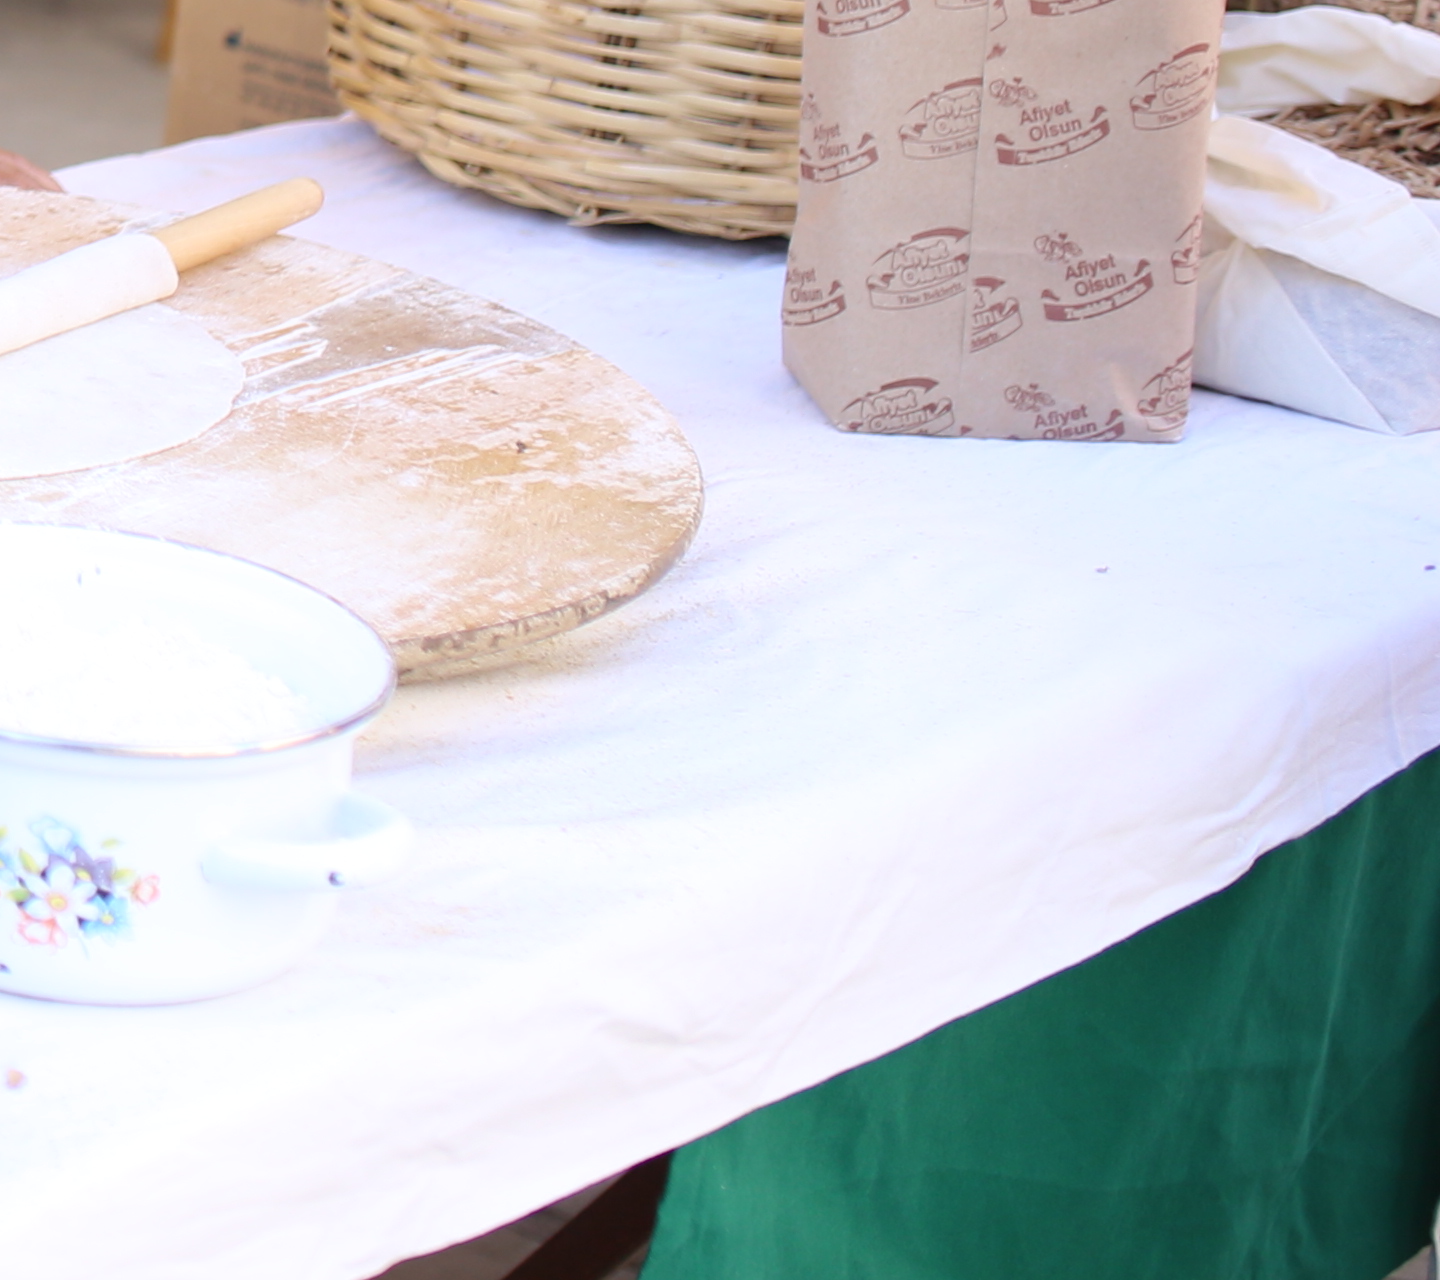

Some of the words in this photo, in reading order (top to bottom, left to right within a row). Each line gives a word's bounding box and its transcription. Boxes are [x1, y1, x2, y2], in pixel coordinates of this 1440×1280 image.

[1020, 99, 1073, 126] Afiyet
[812, 123, 842, 145] Afiyet
[1029, 118, 1082, 141] Olsun
[1065, 253, 1117, 281] Afiyet
[1074, 273, 1127, 297] Olsun
[1034, 404, 1088, 428] Afiyet
[1042, 421, 1097, 440] Olsun
